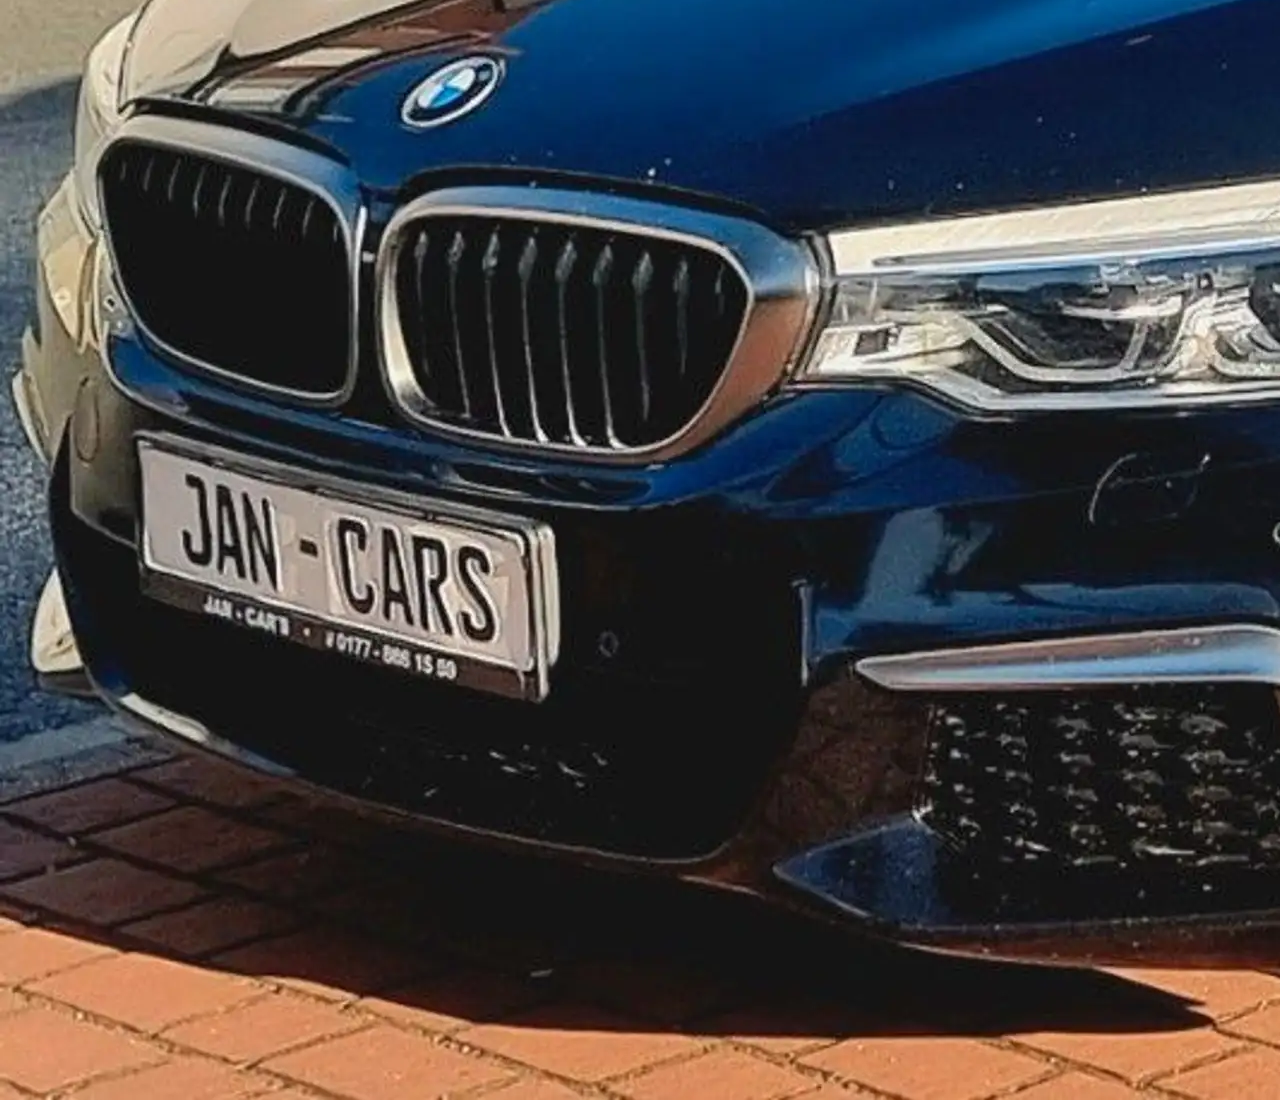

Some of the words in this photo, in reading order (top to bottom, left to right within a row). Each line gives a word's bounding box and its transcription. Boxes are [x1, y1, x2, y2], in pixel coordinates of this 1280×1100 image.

[182, 474, 279, 591] JAN
[300, 538, 319, 557] -
[337, 518, 496, 642] CARS
